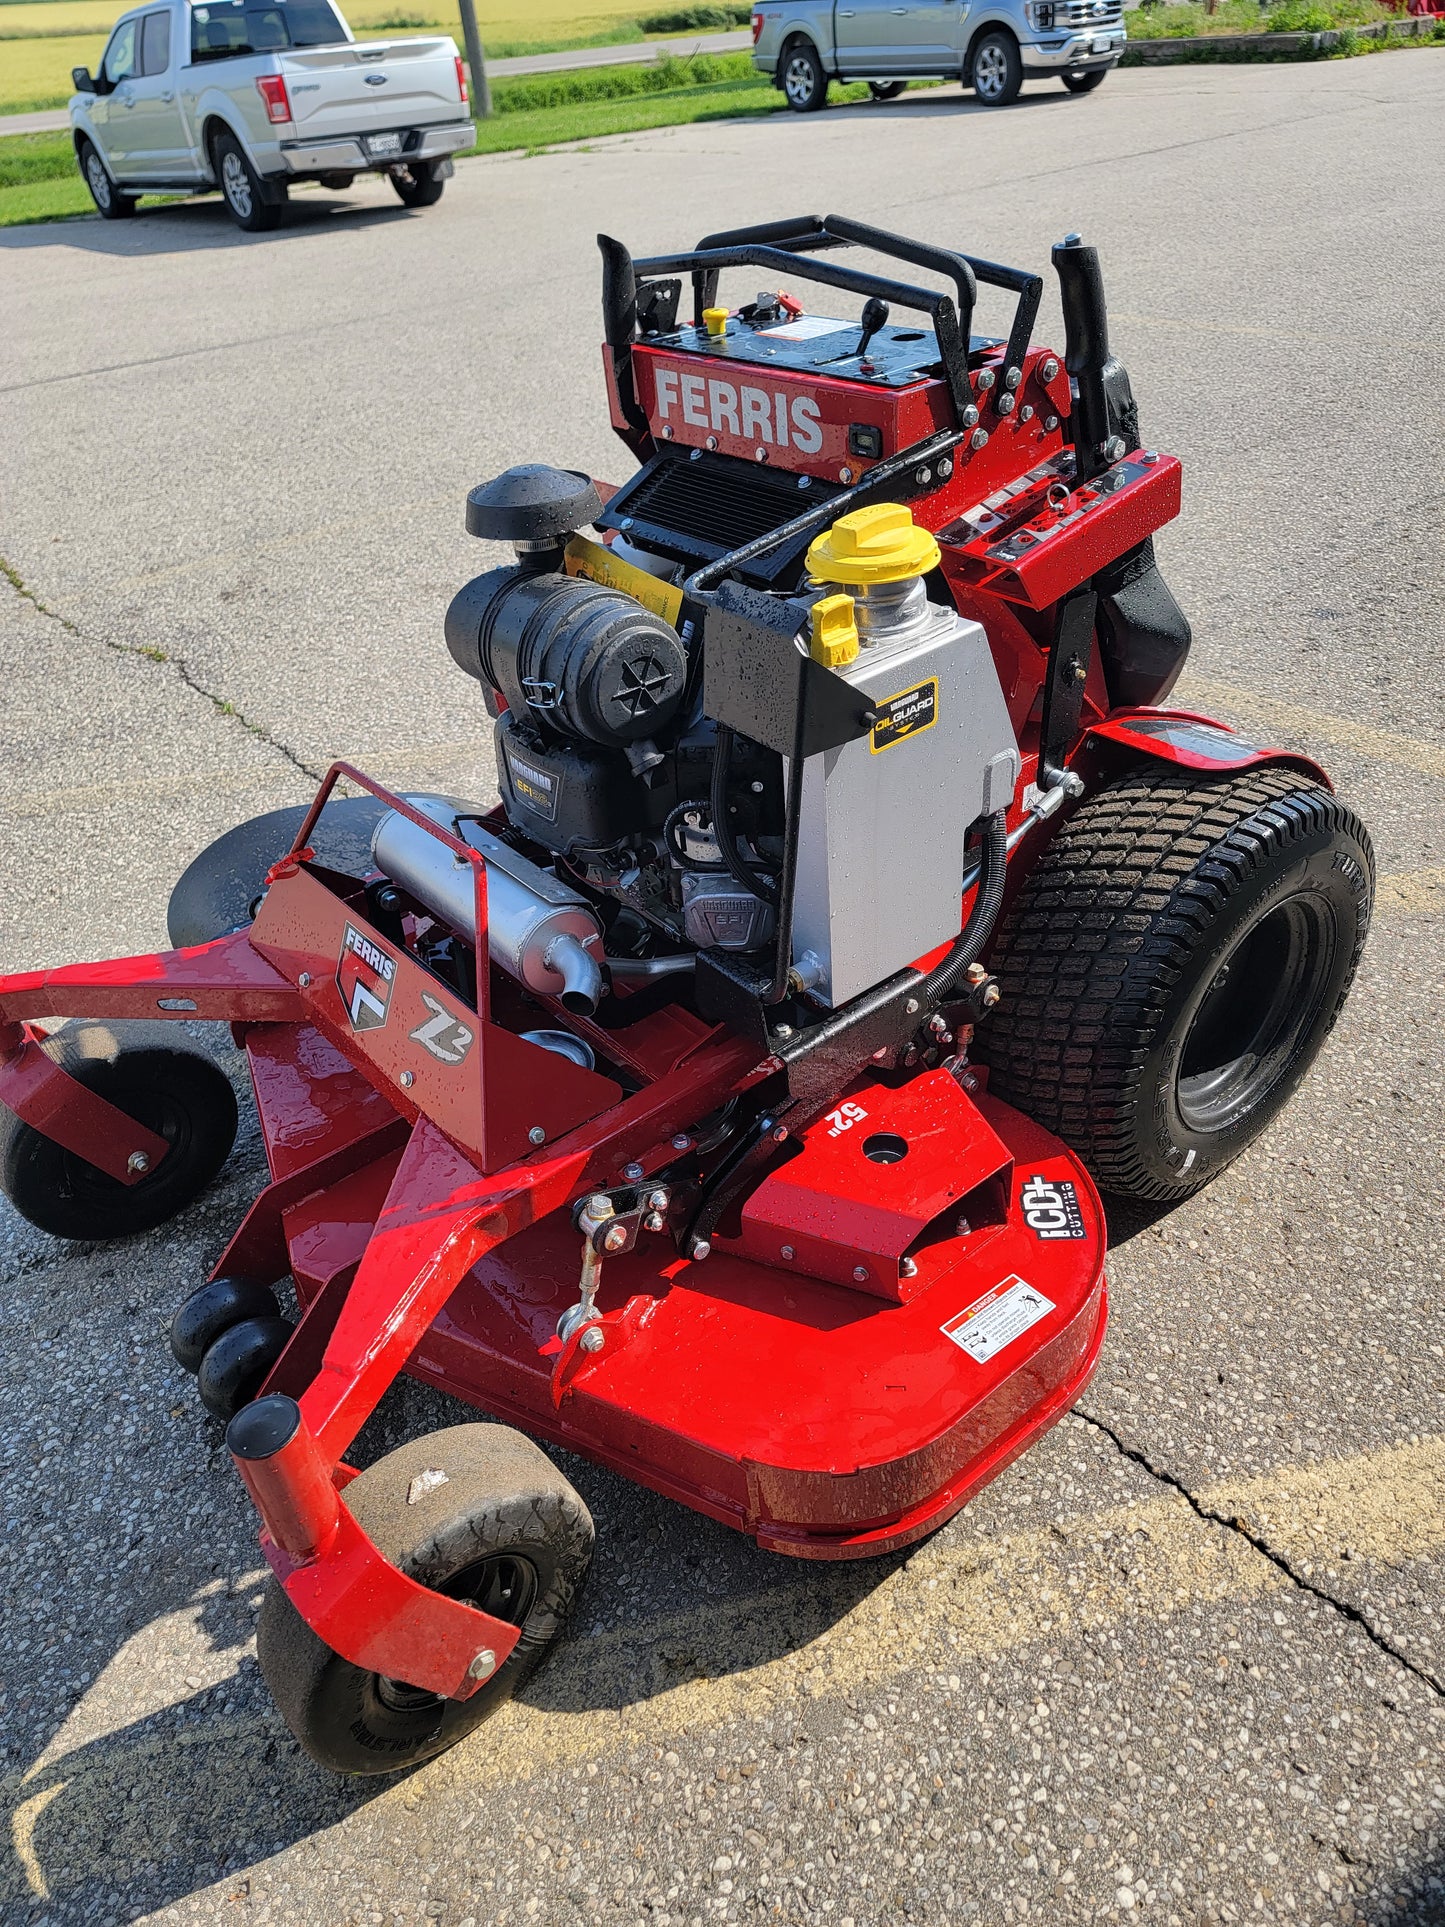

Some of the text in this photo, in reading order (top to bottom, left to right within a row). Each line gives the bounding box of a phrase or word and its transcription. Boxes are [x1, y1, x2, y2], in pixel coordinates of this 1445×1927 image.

[655, 368, 823, 454] FERRIS
[875, 697, 934, 732] OILGUARD
[517, 779, 533, 797] EFI
[716, 915, 744, 924] EFI
[346, 927, 393, 980] FERRIS
[410, 994, 473, 1061] Z2
[824, 1102, 869, 1138] 52"
[1061, 1183, 1084, 1237] CUTTING
[971, 1292, 998, 1313] DANGER
